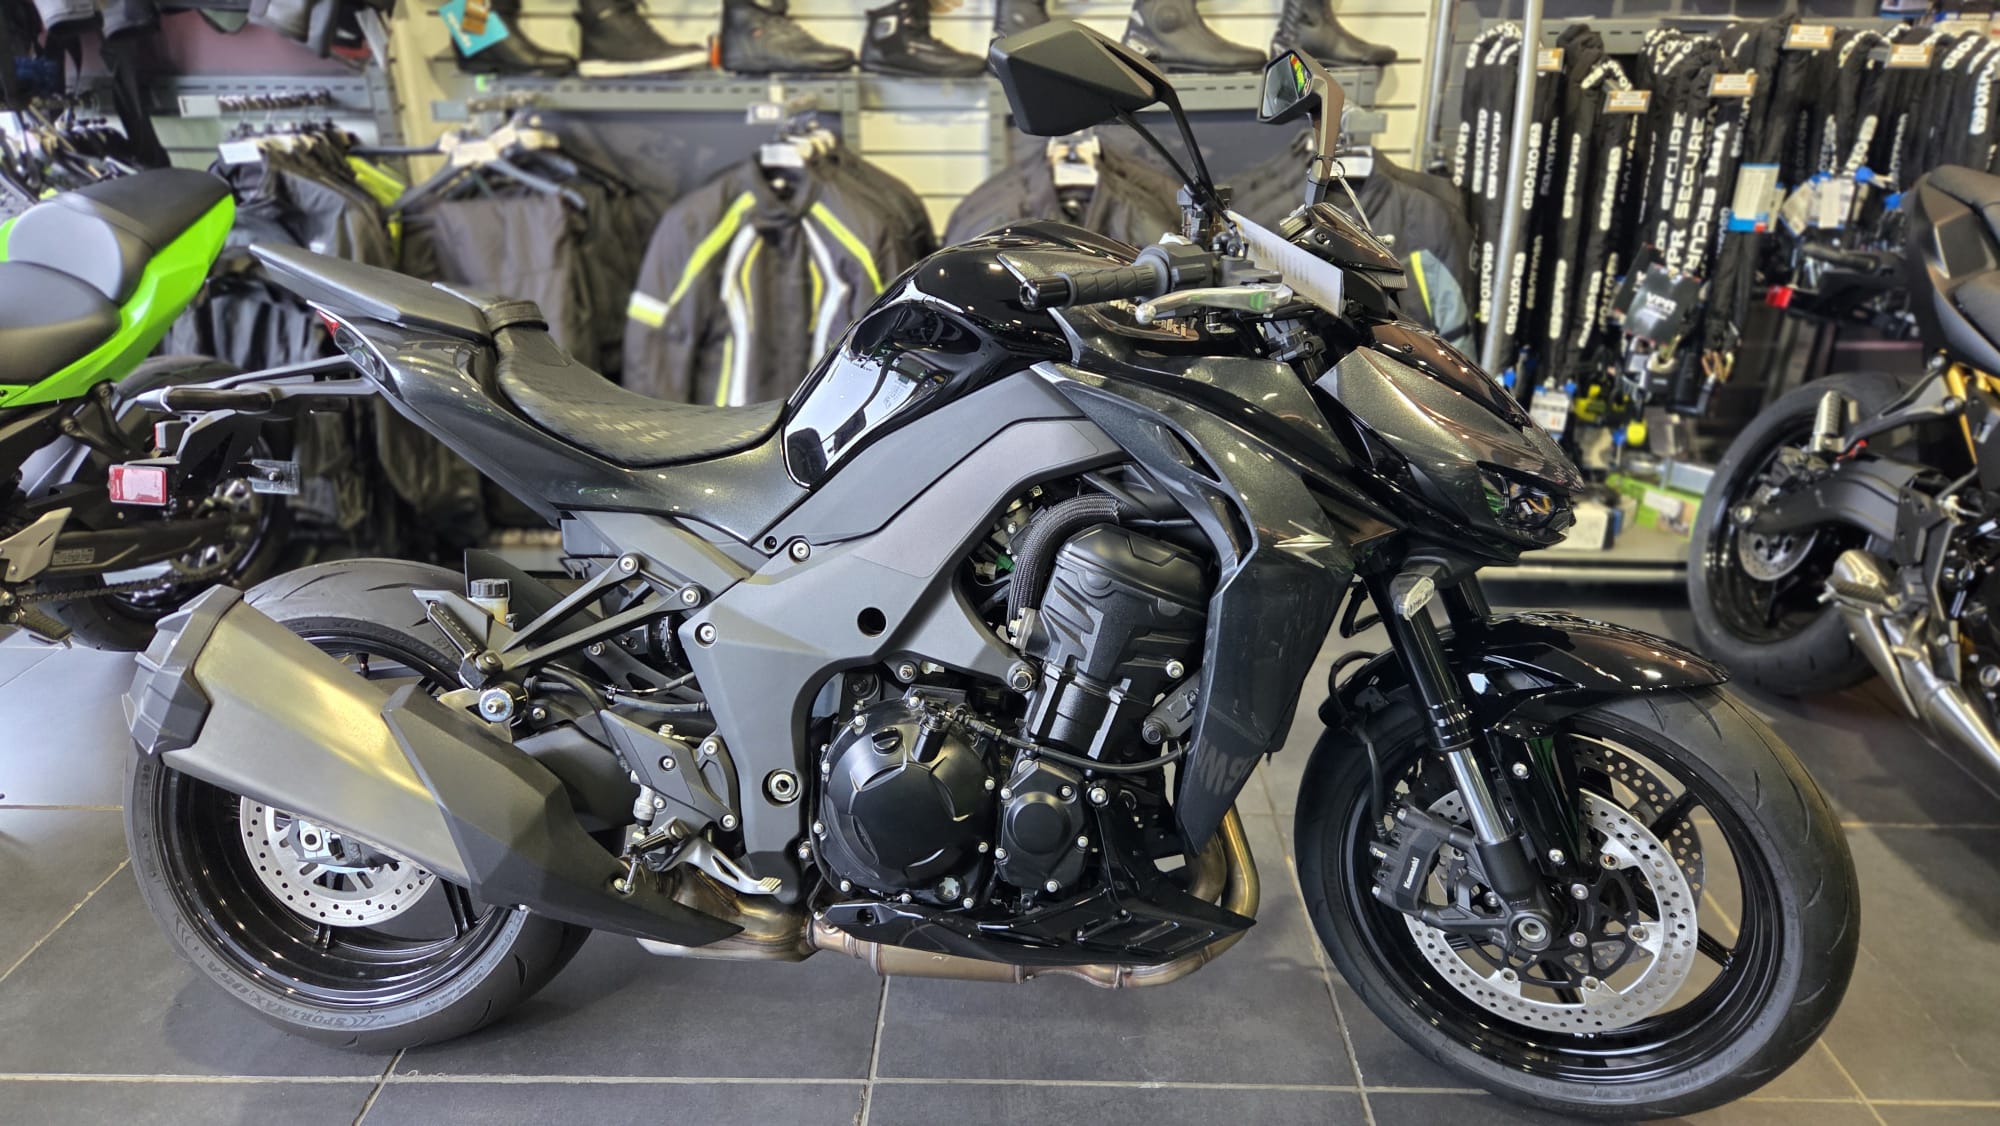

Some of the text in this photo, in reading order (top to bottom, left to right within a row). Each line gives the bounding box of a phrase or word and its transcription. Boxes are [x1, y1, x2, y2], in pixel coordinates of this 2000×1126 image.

[1452, 121, 1471, 187] OXFORD
[1673, 116, 1705, 219] SECURE
[1704, 121, 1730, 177] VPR
[1523, 149, 1540, 210] OXFORD
[1683, 187, 1717, 275] SECUR
[1480, 241, 1494, 300] OXFORD
[1505, 276, 1522, 336] OXFORD
[252, 994, 347, 1028] SPORTMAX
